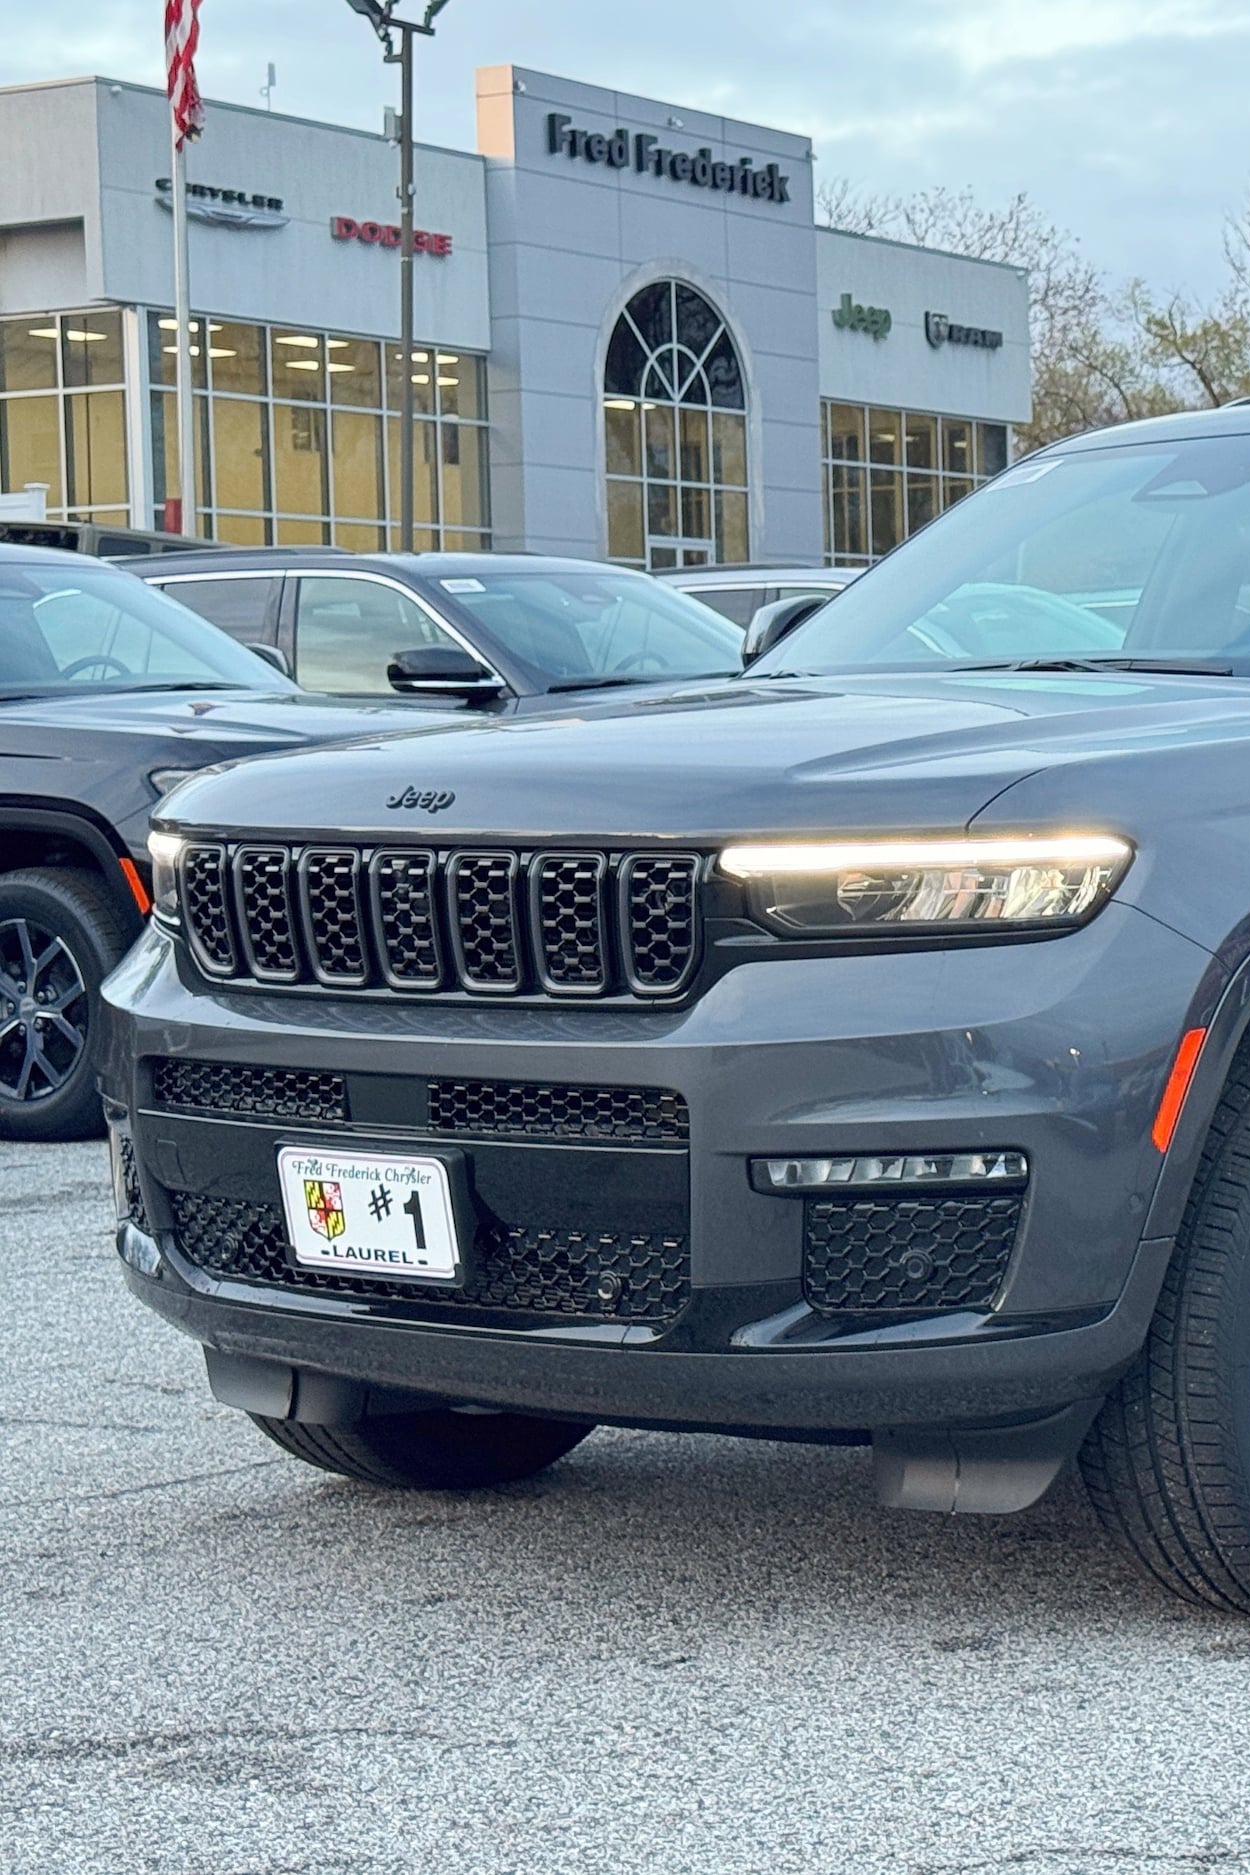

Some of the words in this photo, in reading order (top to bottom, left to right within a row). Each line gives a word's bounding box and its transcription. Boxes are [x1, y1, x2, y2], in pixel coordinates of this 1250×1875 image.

[547, 113, 629, 169] Fred
[634, 133, 790, 203] Frederick
[330, 216, 453, 256] DODGE
[831, 293, 892, 341] Jeep
[386, 785, 456, 814] Jeep
[292, 1159, 322, 1177] Fred
[325, 1163, 381, 1181] Frederick
[385, 1167, 432, 1186] Chrysler
[332, 1244, 414, 1265] LAUREL
